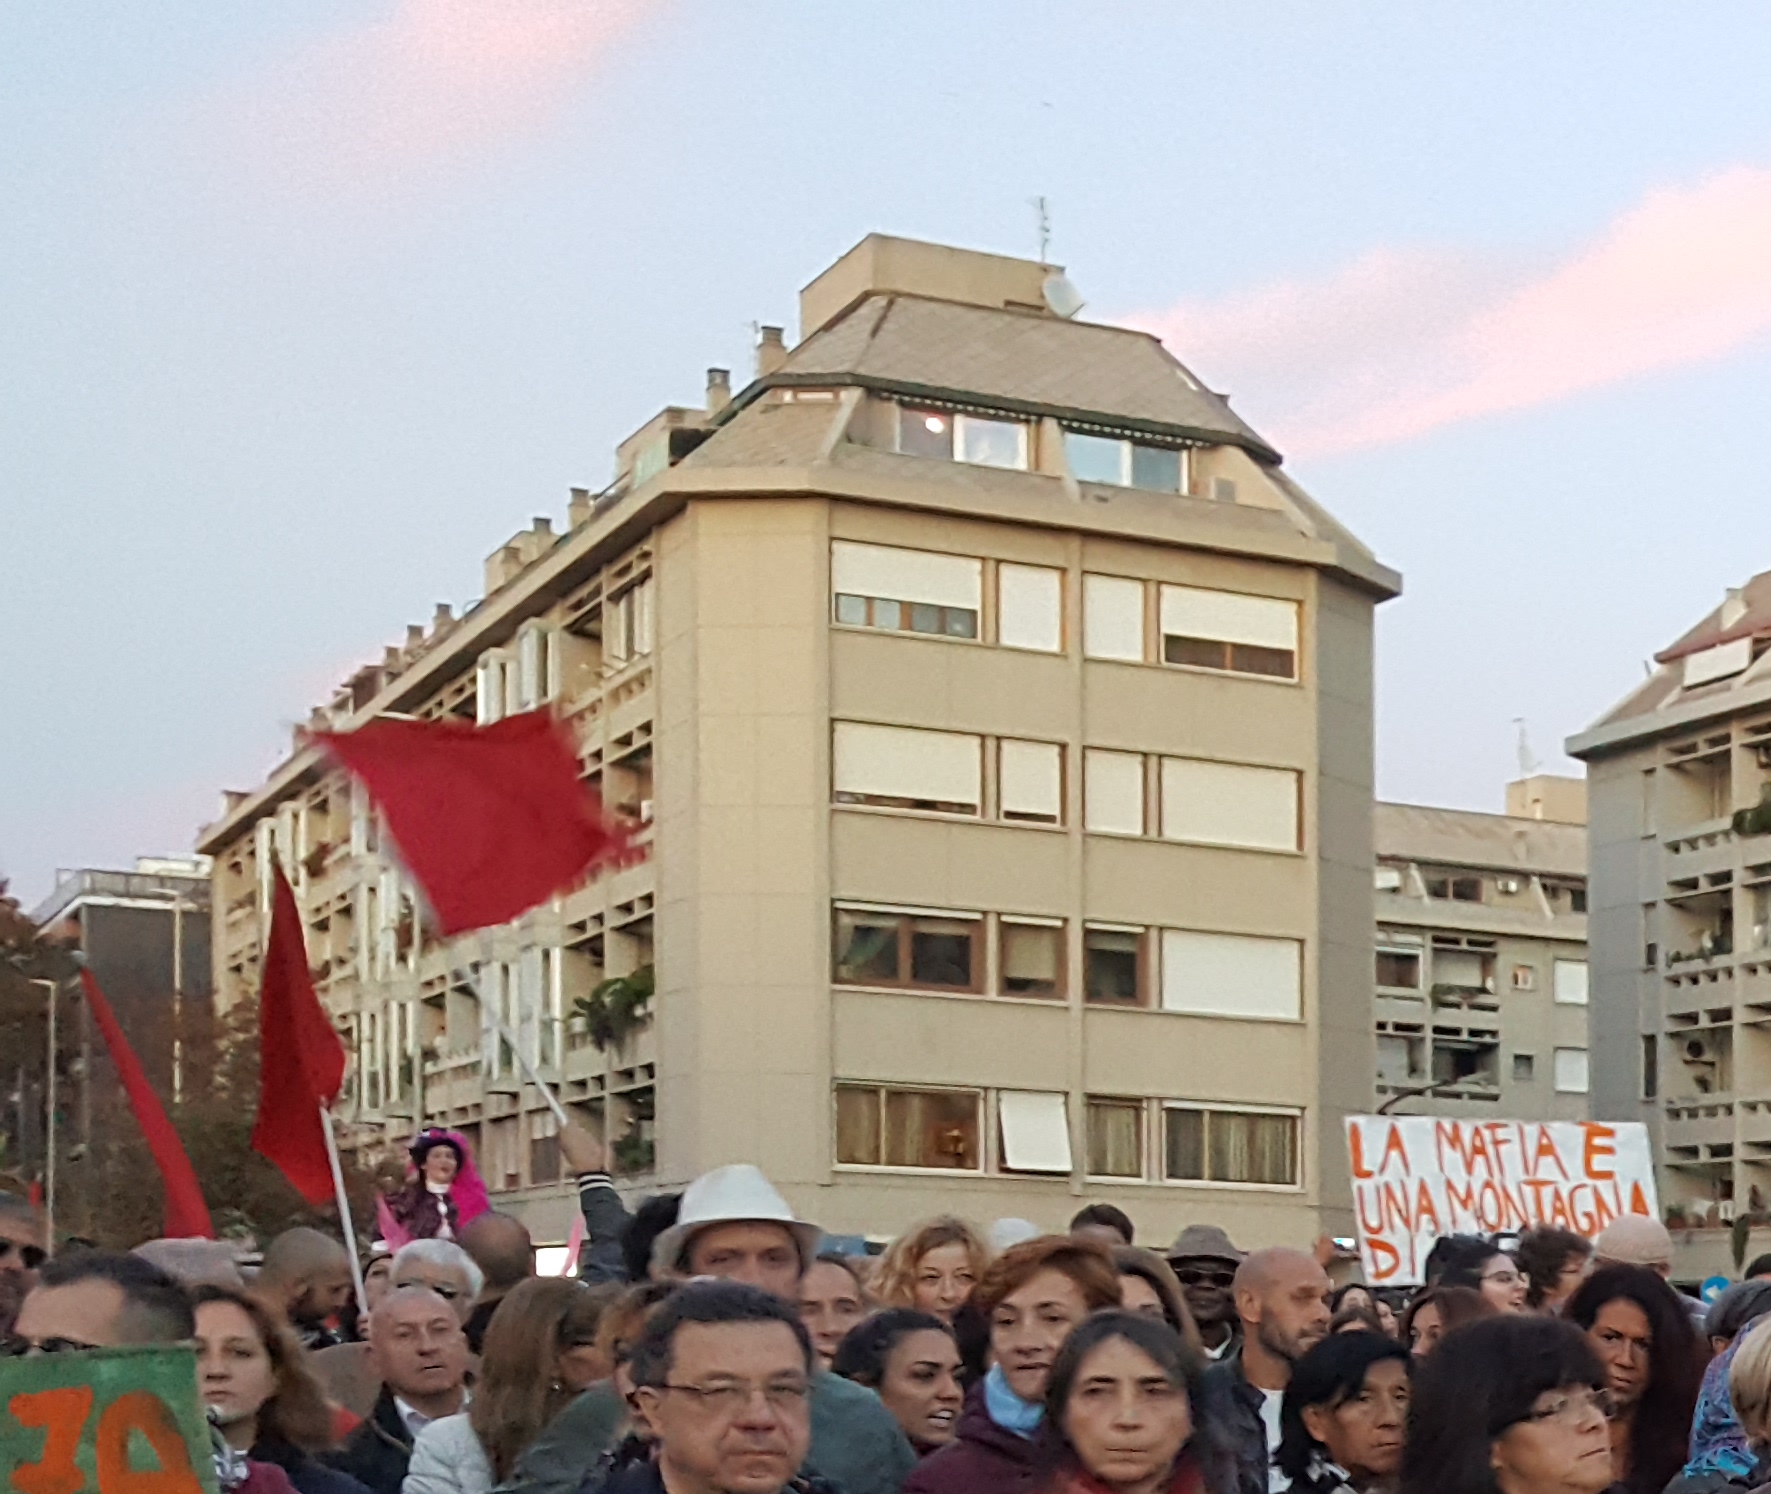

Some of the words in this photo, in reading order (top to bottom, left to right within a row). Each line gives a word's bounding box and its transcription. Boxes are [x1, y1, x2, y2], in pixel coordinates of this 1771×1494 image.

[1349, 1121, 1411, 1179] LA
[1435, 1120, 1571, 1181] MAFIA
[1356, 1178, 1441, 1235] UNA
[1444, 1179, 1651, 1237] MONTAGNA
[1366, 1231, 1416, 1280] DI
